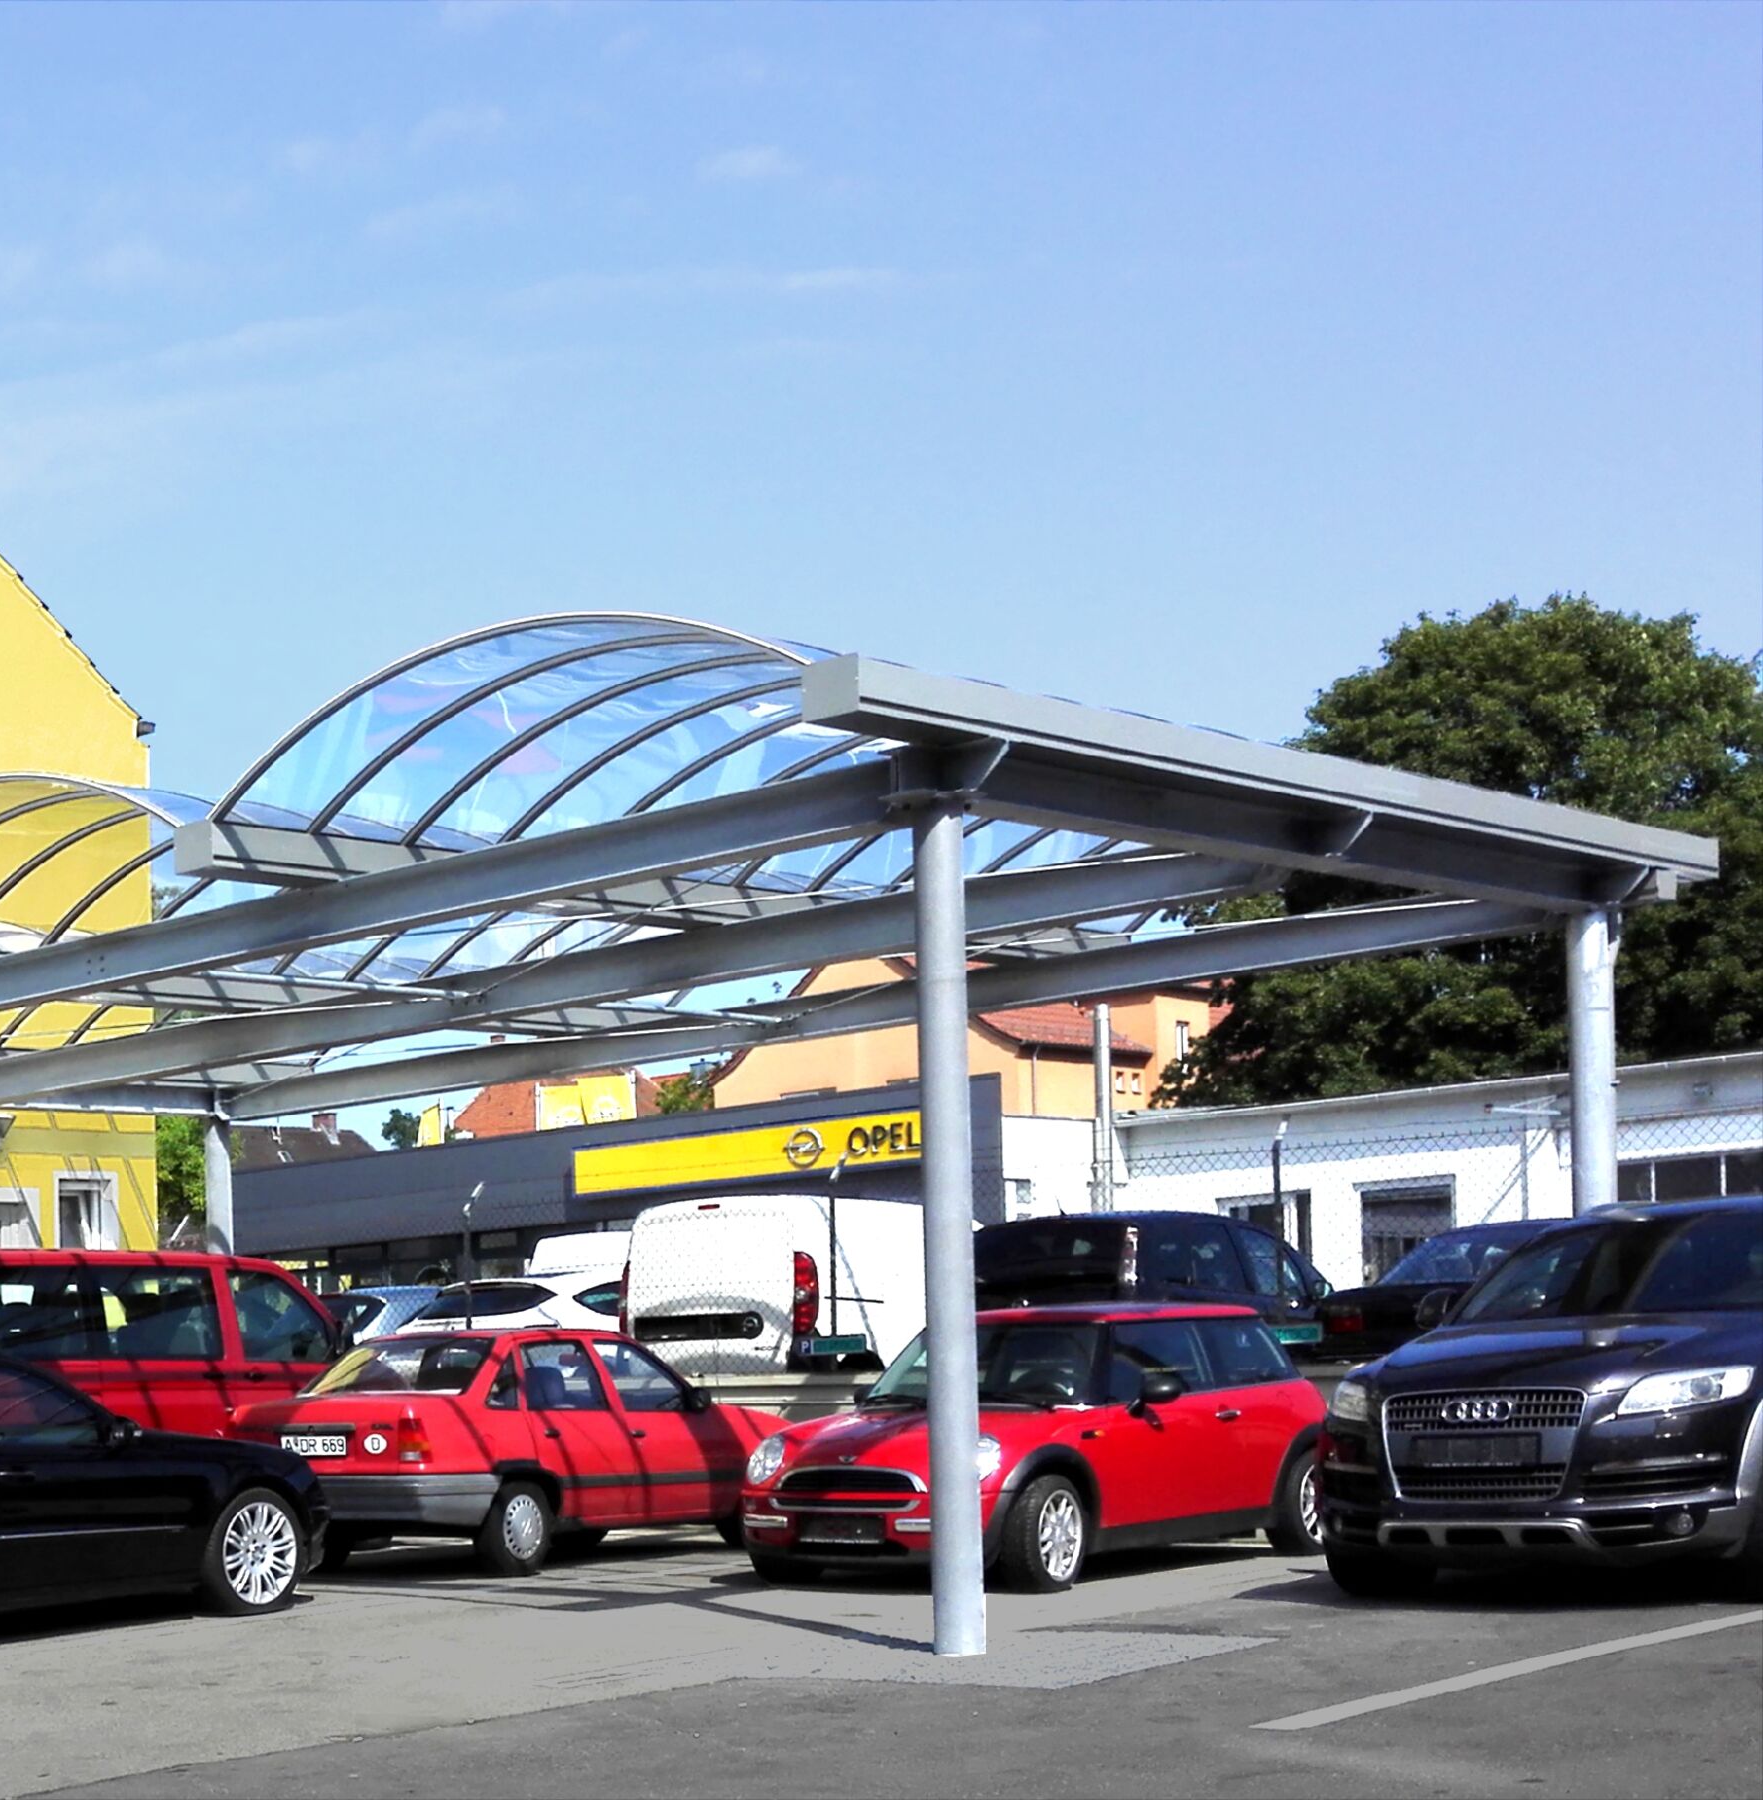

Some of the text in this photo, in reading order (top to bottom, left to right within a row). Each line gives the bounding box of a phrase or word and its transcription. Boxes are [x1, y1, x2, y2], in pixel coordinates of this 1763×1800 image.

[848, 1121, 921, 1155] OPEL
[801, 1340, 810, 1354] P
[300, 1438, 317, 1453] DR
[322, 1438, 344, 1453] 669
[370, 1437, 380, 1451] D
